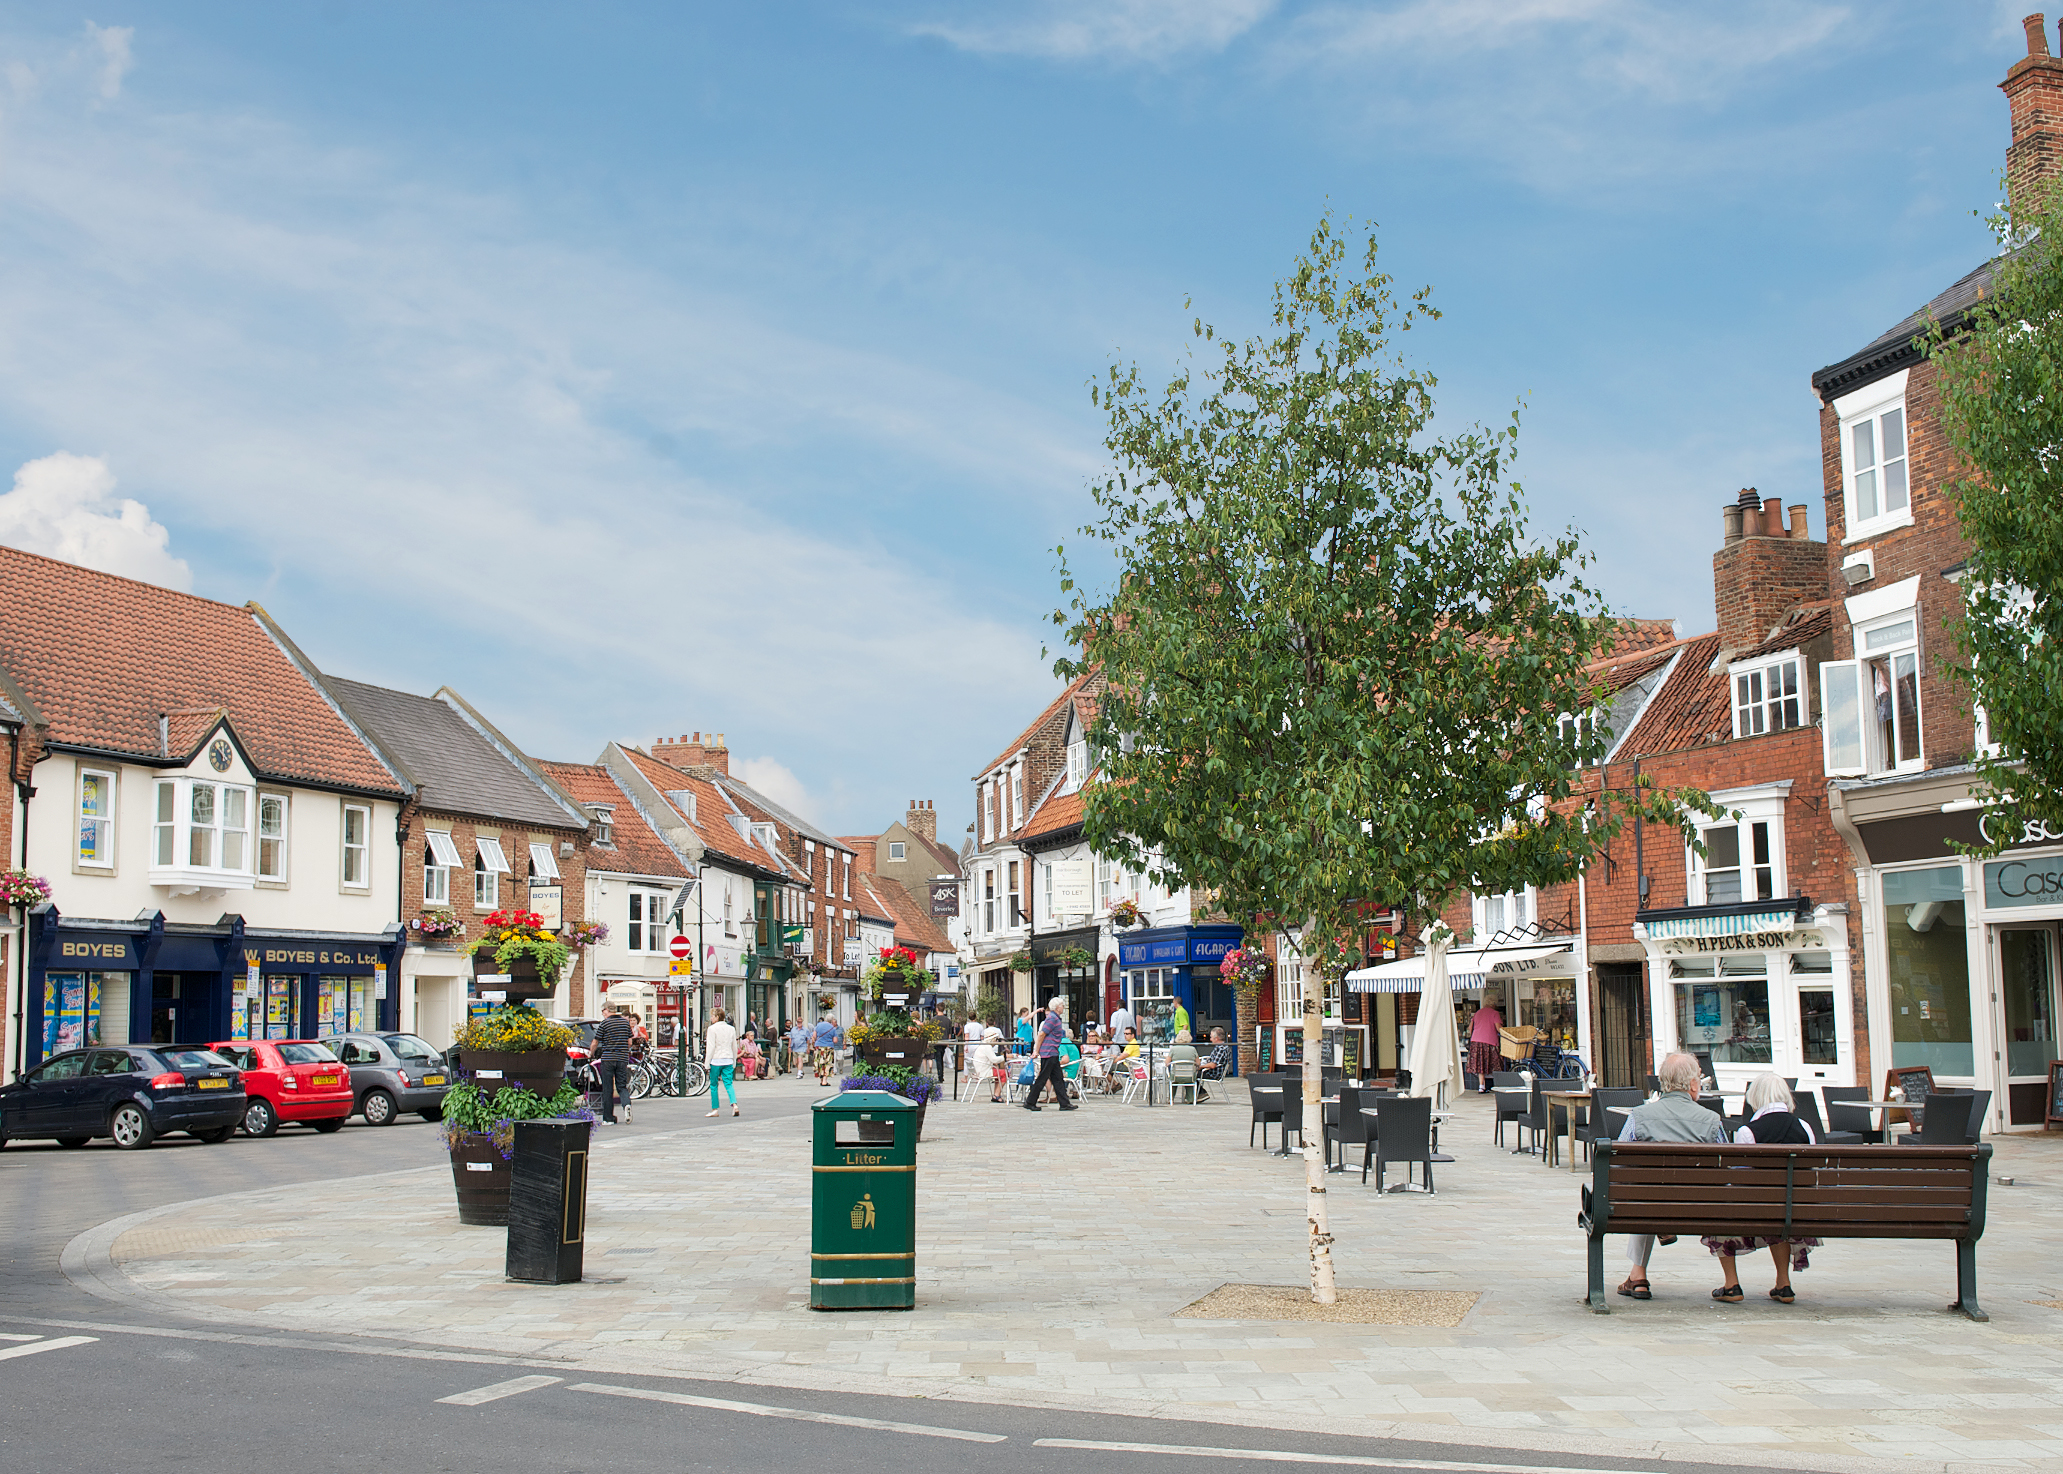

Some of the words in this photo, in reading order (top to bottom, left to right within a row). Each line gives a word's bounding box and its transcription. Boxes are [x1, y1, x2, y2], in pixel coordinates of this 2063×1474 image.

[933, 887, 956, 900] ASK
[1746, 934, 1755, 948] &
[1757, 932, 1785, 947] SON
[62, 942, 126, 958] BOYES
[851, 952, 860, 960] Let
[1125, 946, 1146, 962] FIGARO
[1196, 943, 1235, 956] FIGARO
[244, 949, 261, 961] W.
[266, 950, 315, 963] BOYES
[320, 951, 330, 963] &
[334, 952, 354, 964] Co.
[357, 953, 381, 965] Ltd.
[1517, 960, 1540, 972] LTD.
[846, 1153, 882, 1164] Litter
